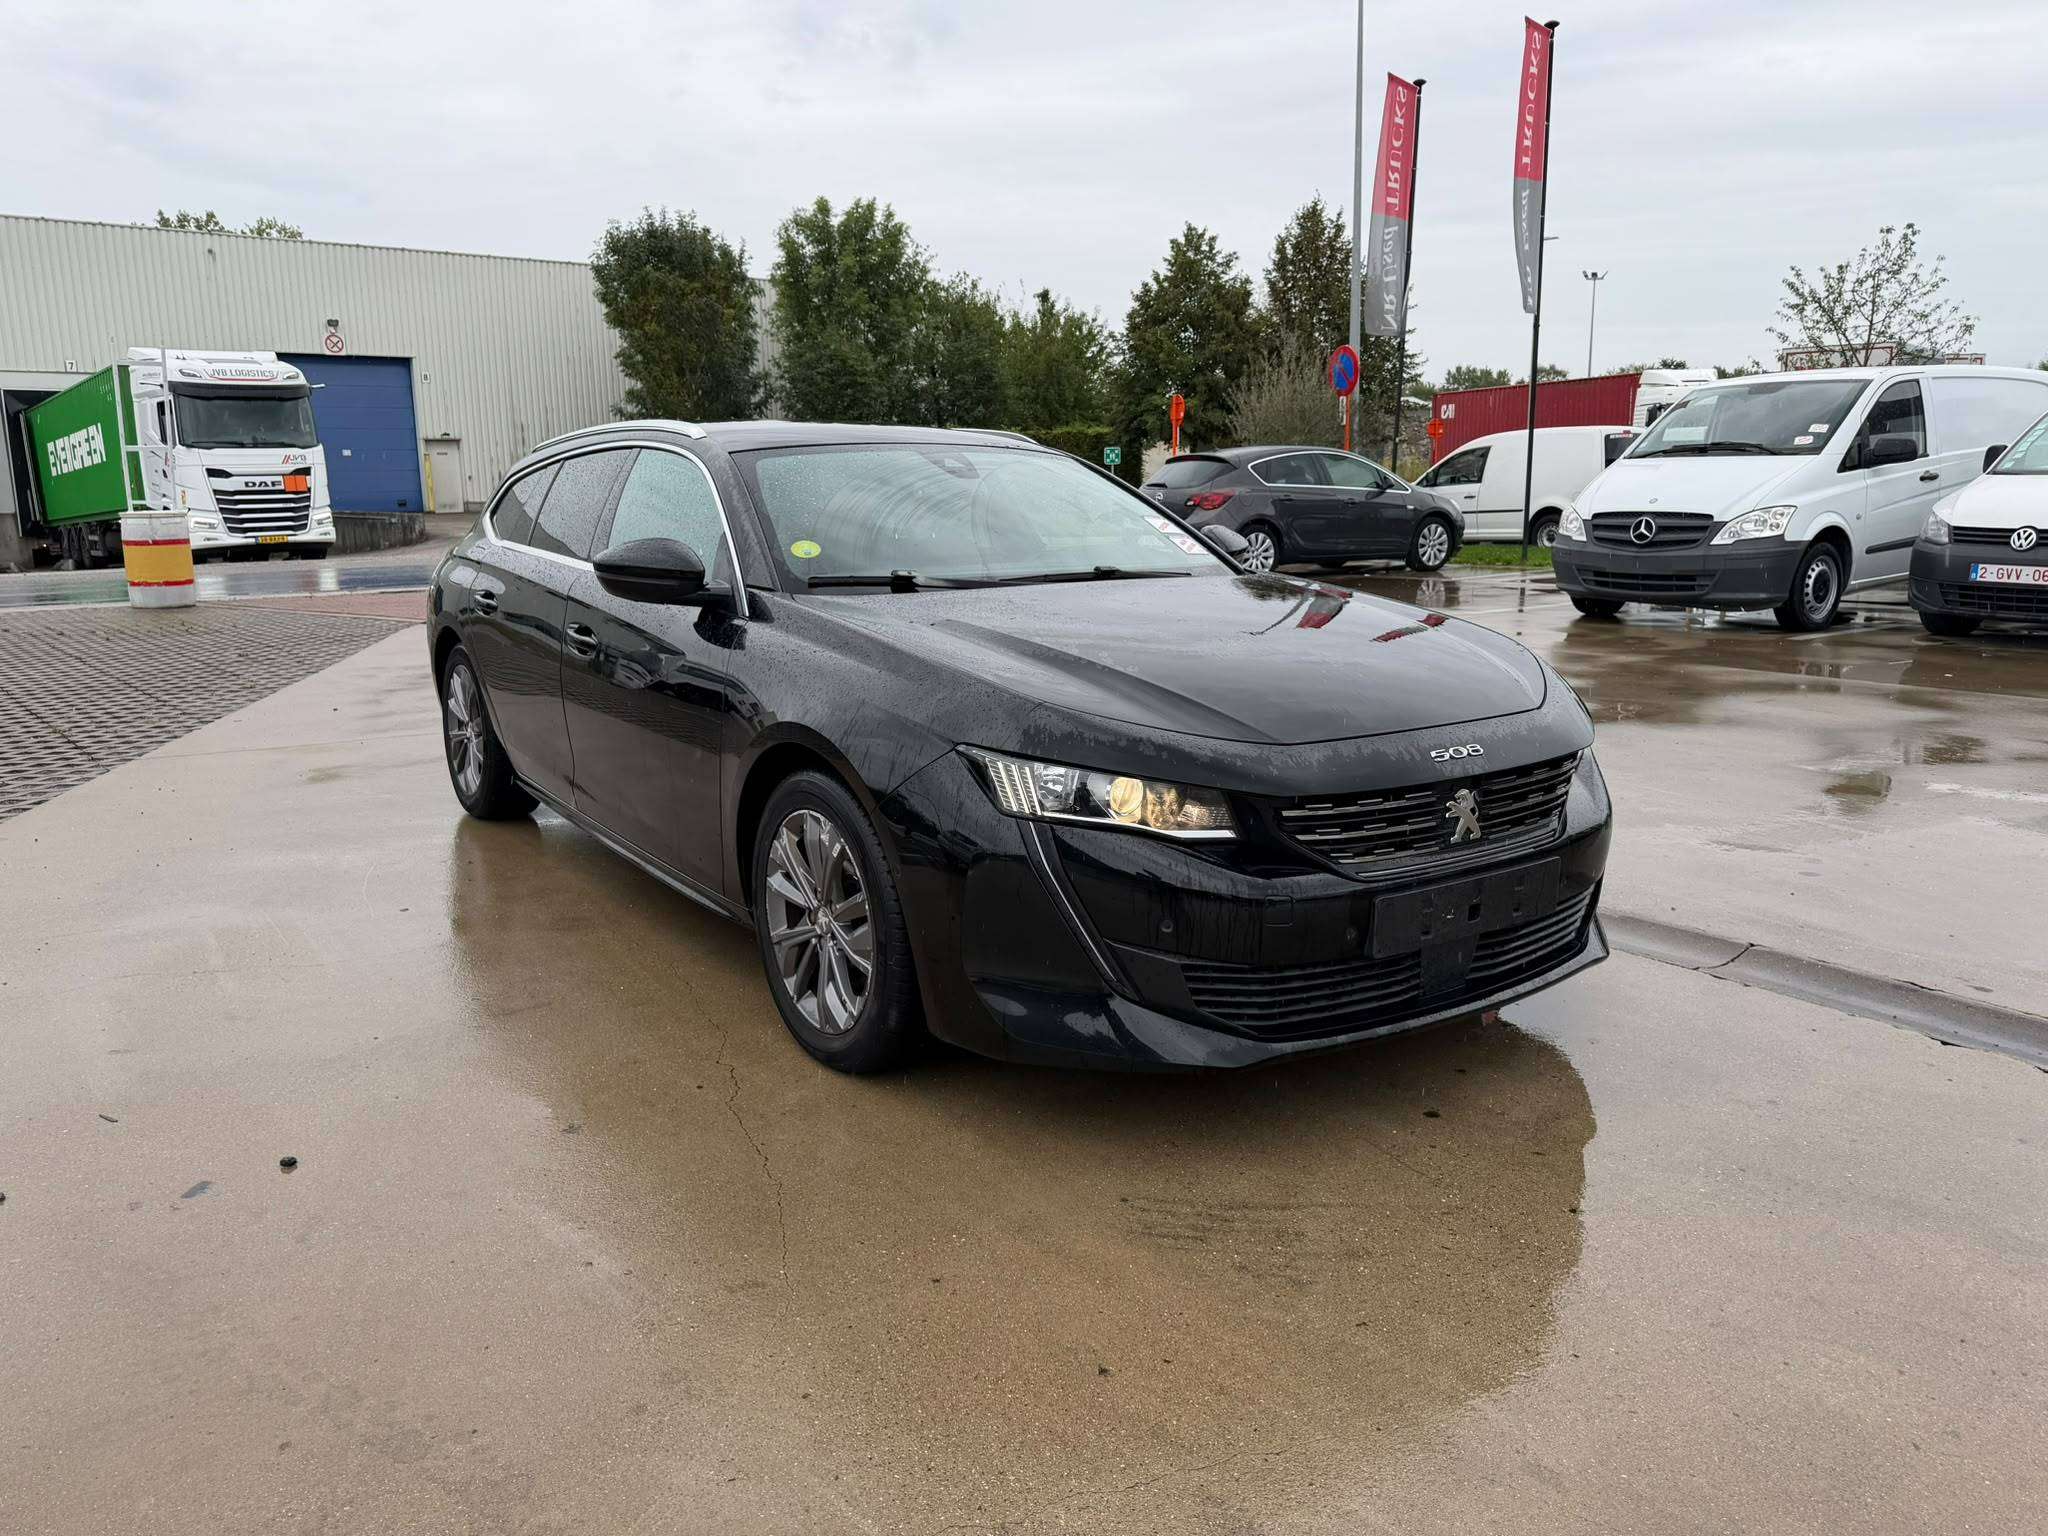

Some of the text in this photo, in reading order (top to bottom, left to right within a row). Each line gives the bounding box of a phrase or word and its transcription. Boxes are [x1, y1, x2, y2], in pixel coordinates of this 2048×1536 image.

[210, 367, 275, 378] JVB LOGISTICS
[47, 422, 106, 477] EVERGREEN
[244, 480, 283, 488] DAF
[1430, 743, 1484, 762] 508
